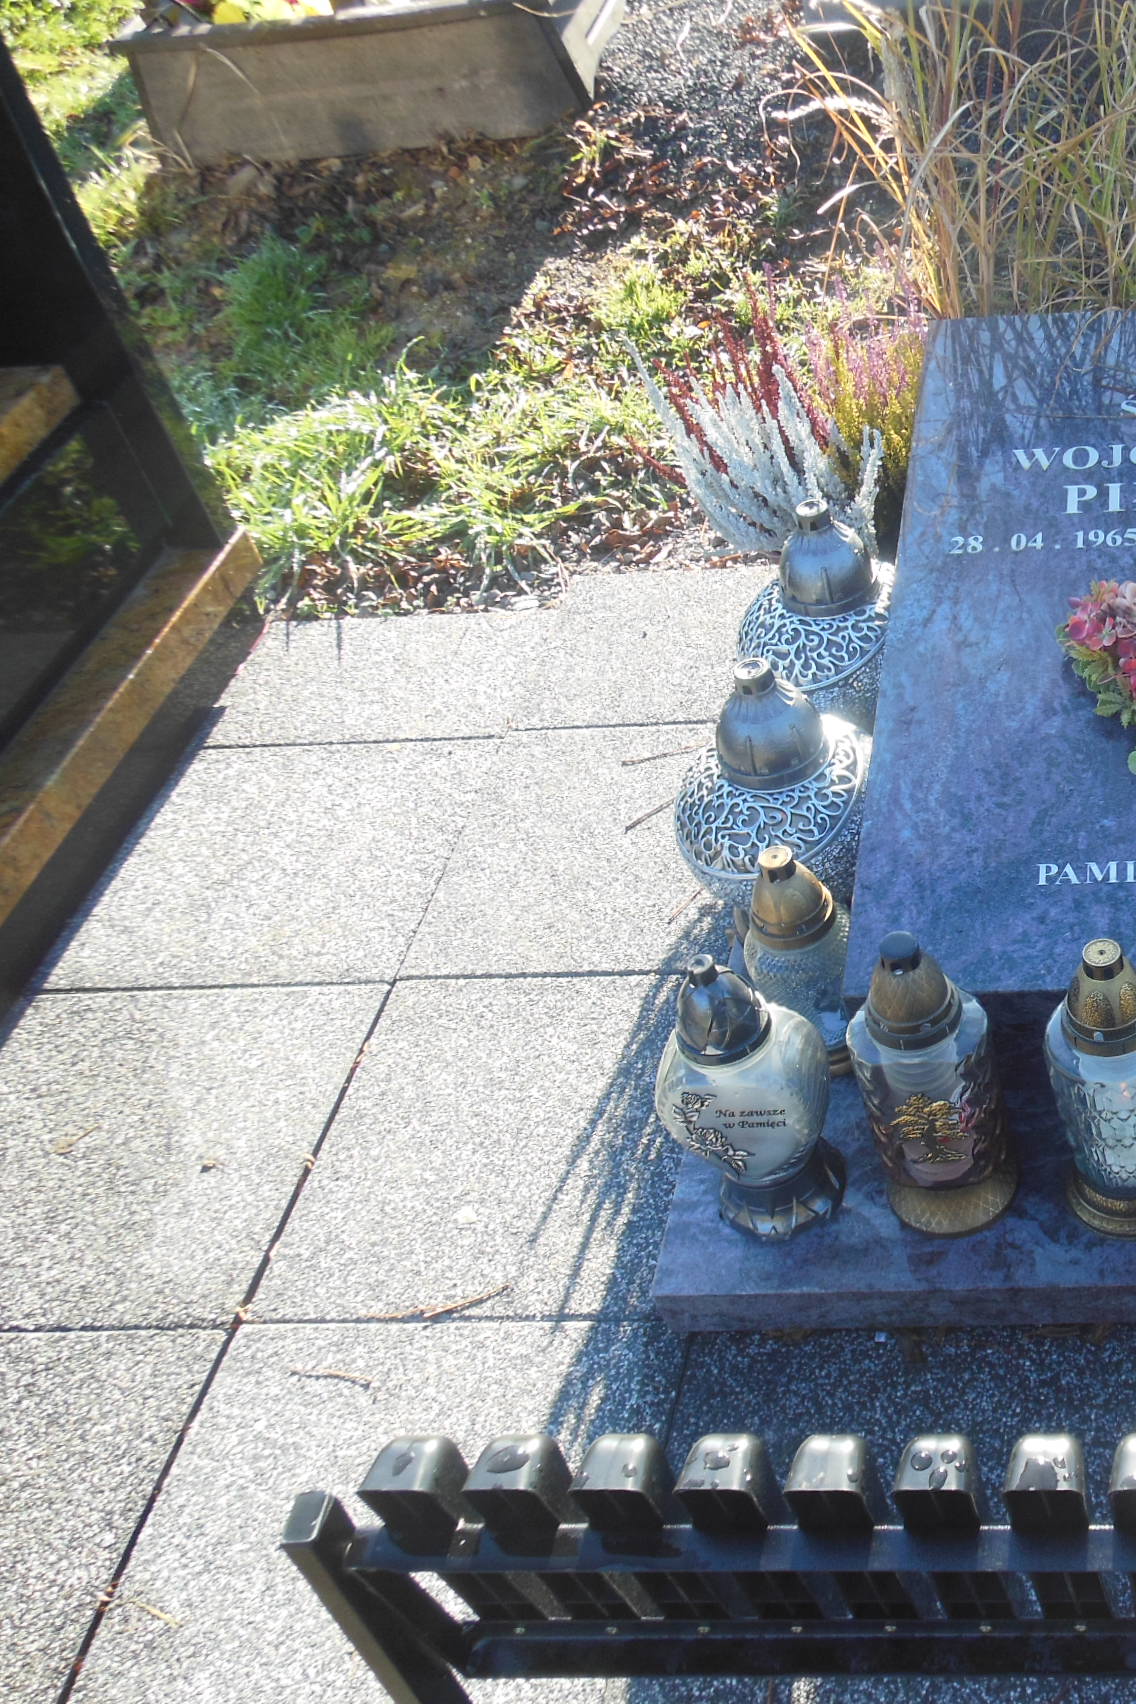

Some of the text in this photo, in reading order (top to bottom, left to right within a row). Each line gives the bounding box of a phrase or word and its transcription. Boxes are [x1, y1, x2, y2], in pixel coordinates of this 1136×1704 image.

[715, 1108, 786, 1118] Na zawsze
[737, 1118, 787, 1129] Pamięci
